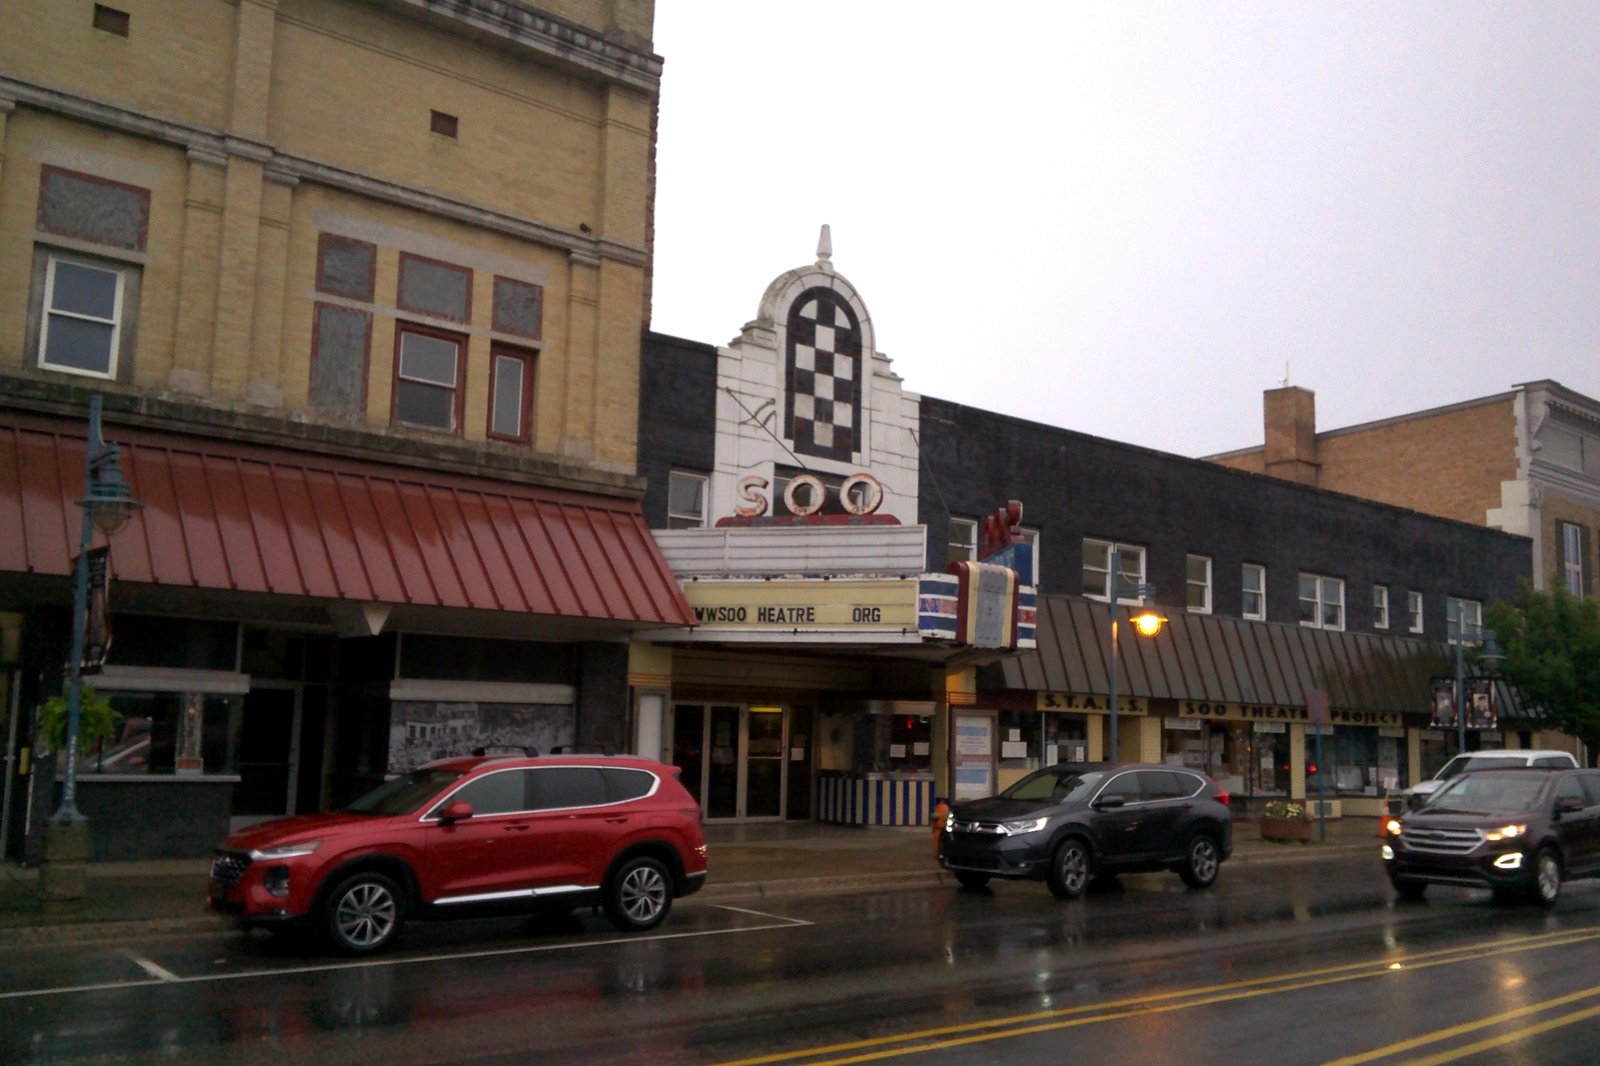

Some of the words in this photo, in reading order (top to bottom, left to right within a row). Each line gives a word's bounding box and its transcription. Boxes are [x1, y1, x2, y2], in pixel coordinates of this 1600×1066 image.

[734, 473, 884, 517] SOO
[757, 606, 815, 623] HEATRE
[852, 607, 881, 623] ORG
[1185, 702, 1227, 716] SOO
[1239, 704, 1309, 720] THEATR
[1329, 709, 1399, 724] PROJECT
